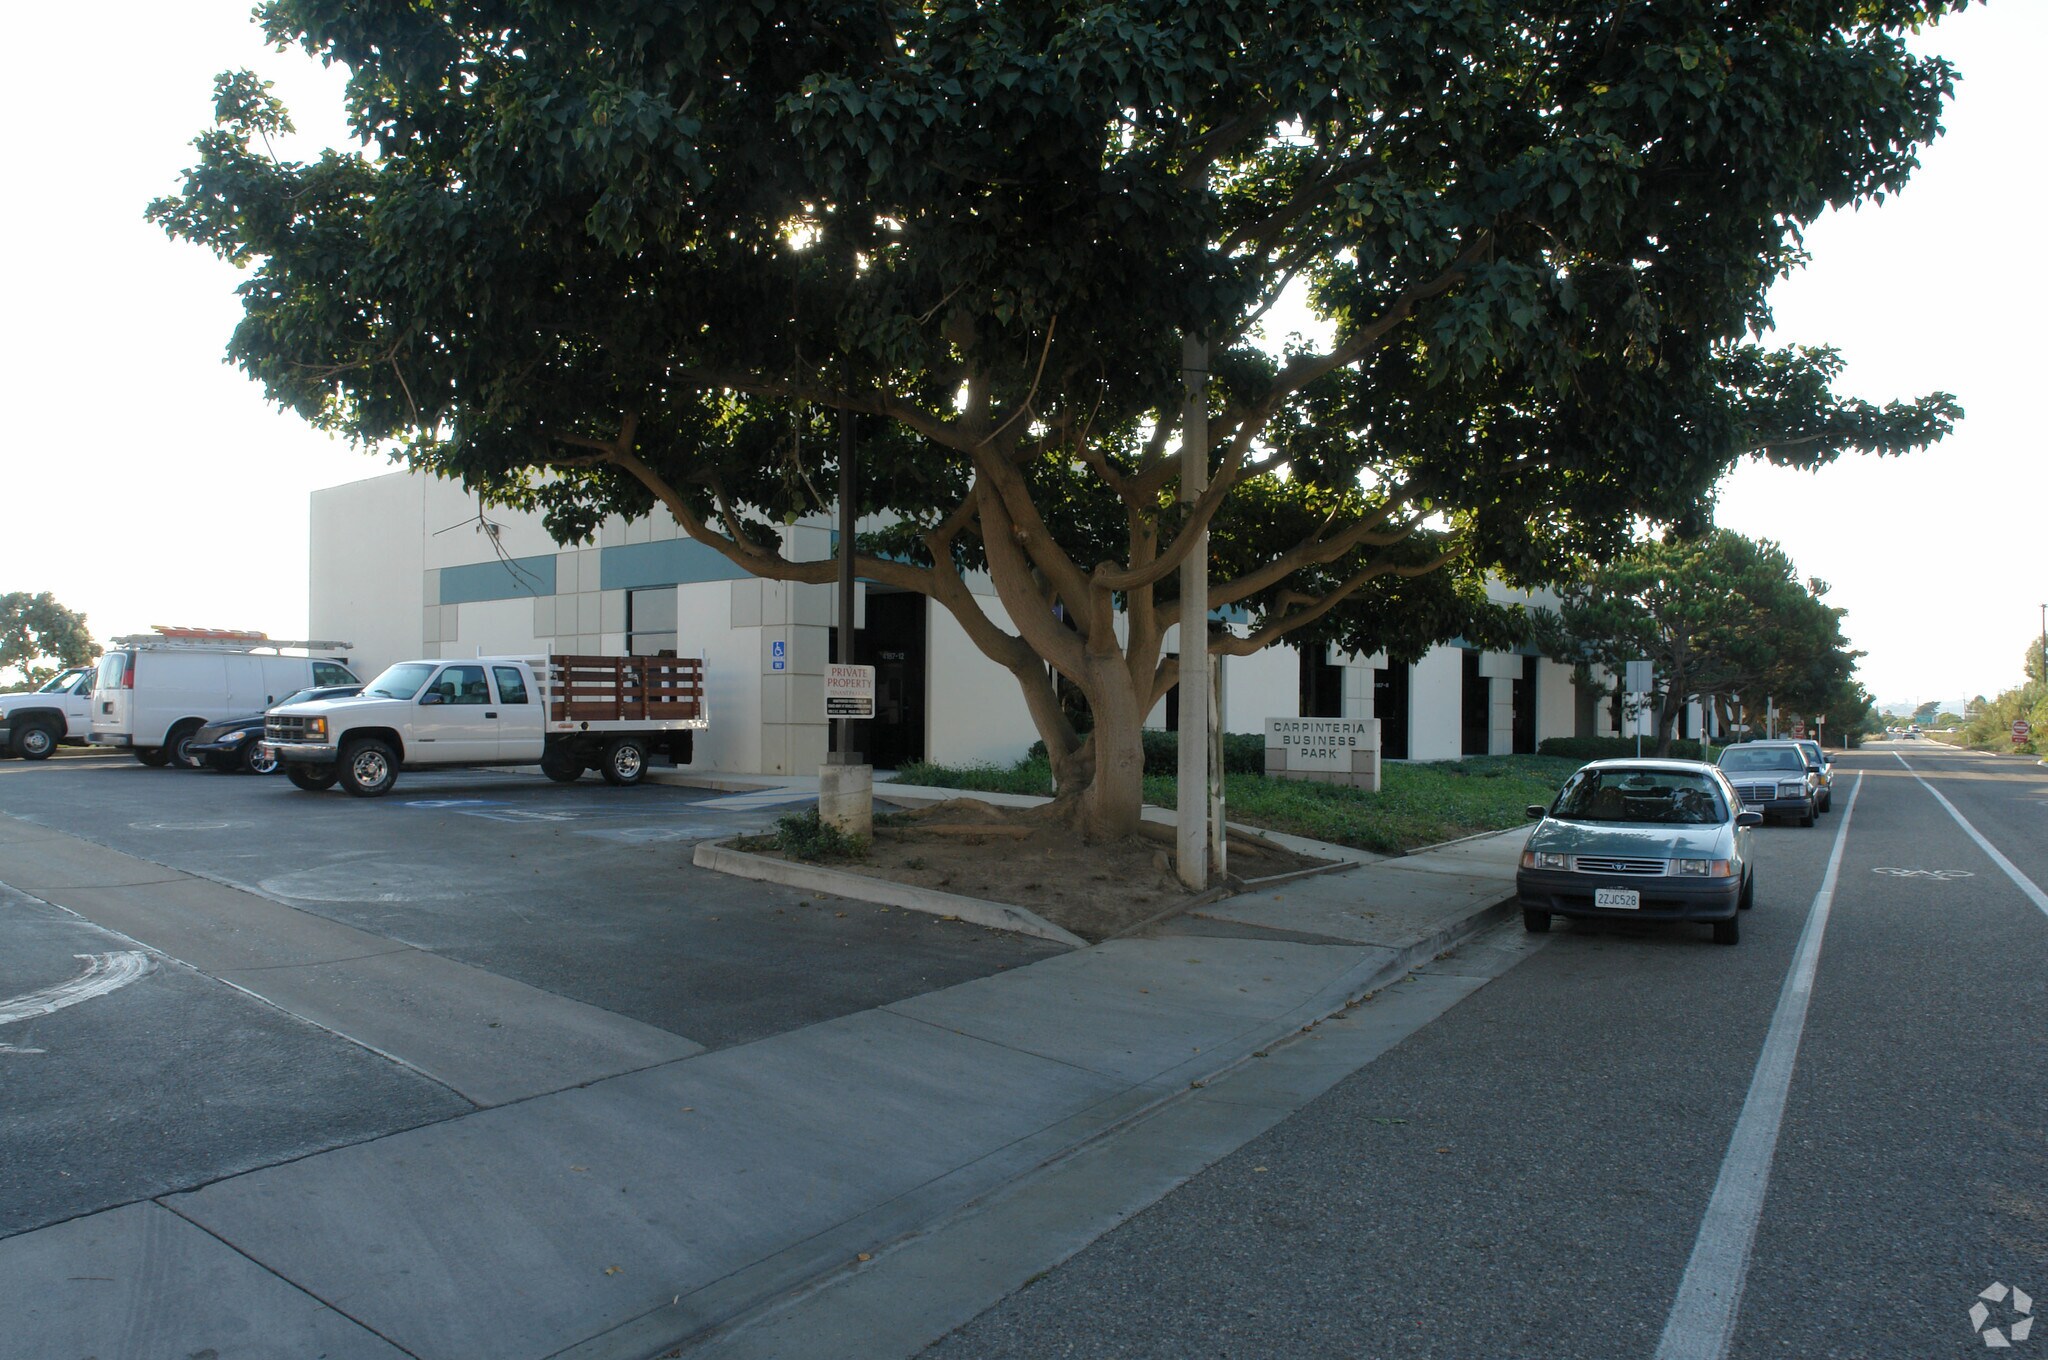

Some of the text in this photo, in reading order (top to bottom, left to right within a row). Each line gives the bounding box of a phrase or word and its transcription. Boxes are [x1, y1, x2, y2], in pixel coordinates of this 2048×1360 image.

[831, 667, 868, 678] PRIVATE
[827, 678, 873, 689] PROPERTY
[1273, 722, 1365, 733] CARPINTERIA
[1283, 735, 1356, 746] BUSINESS
[1301, 748, 1337, 759] PARK
[1598, 893, 1637, 906] 2ZJC528
